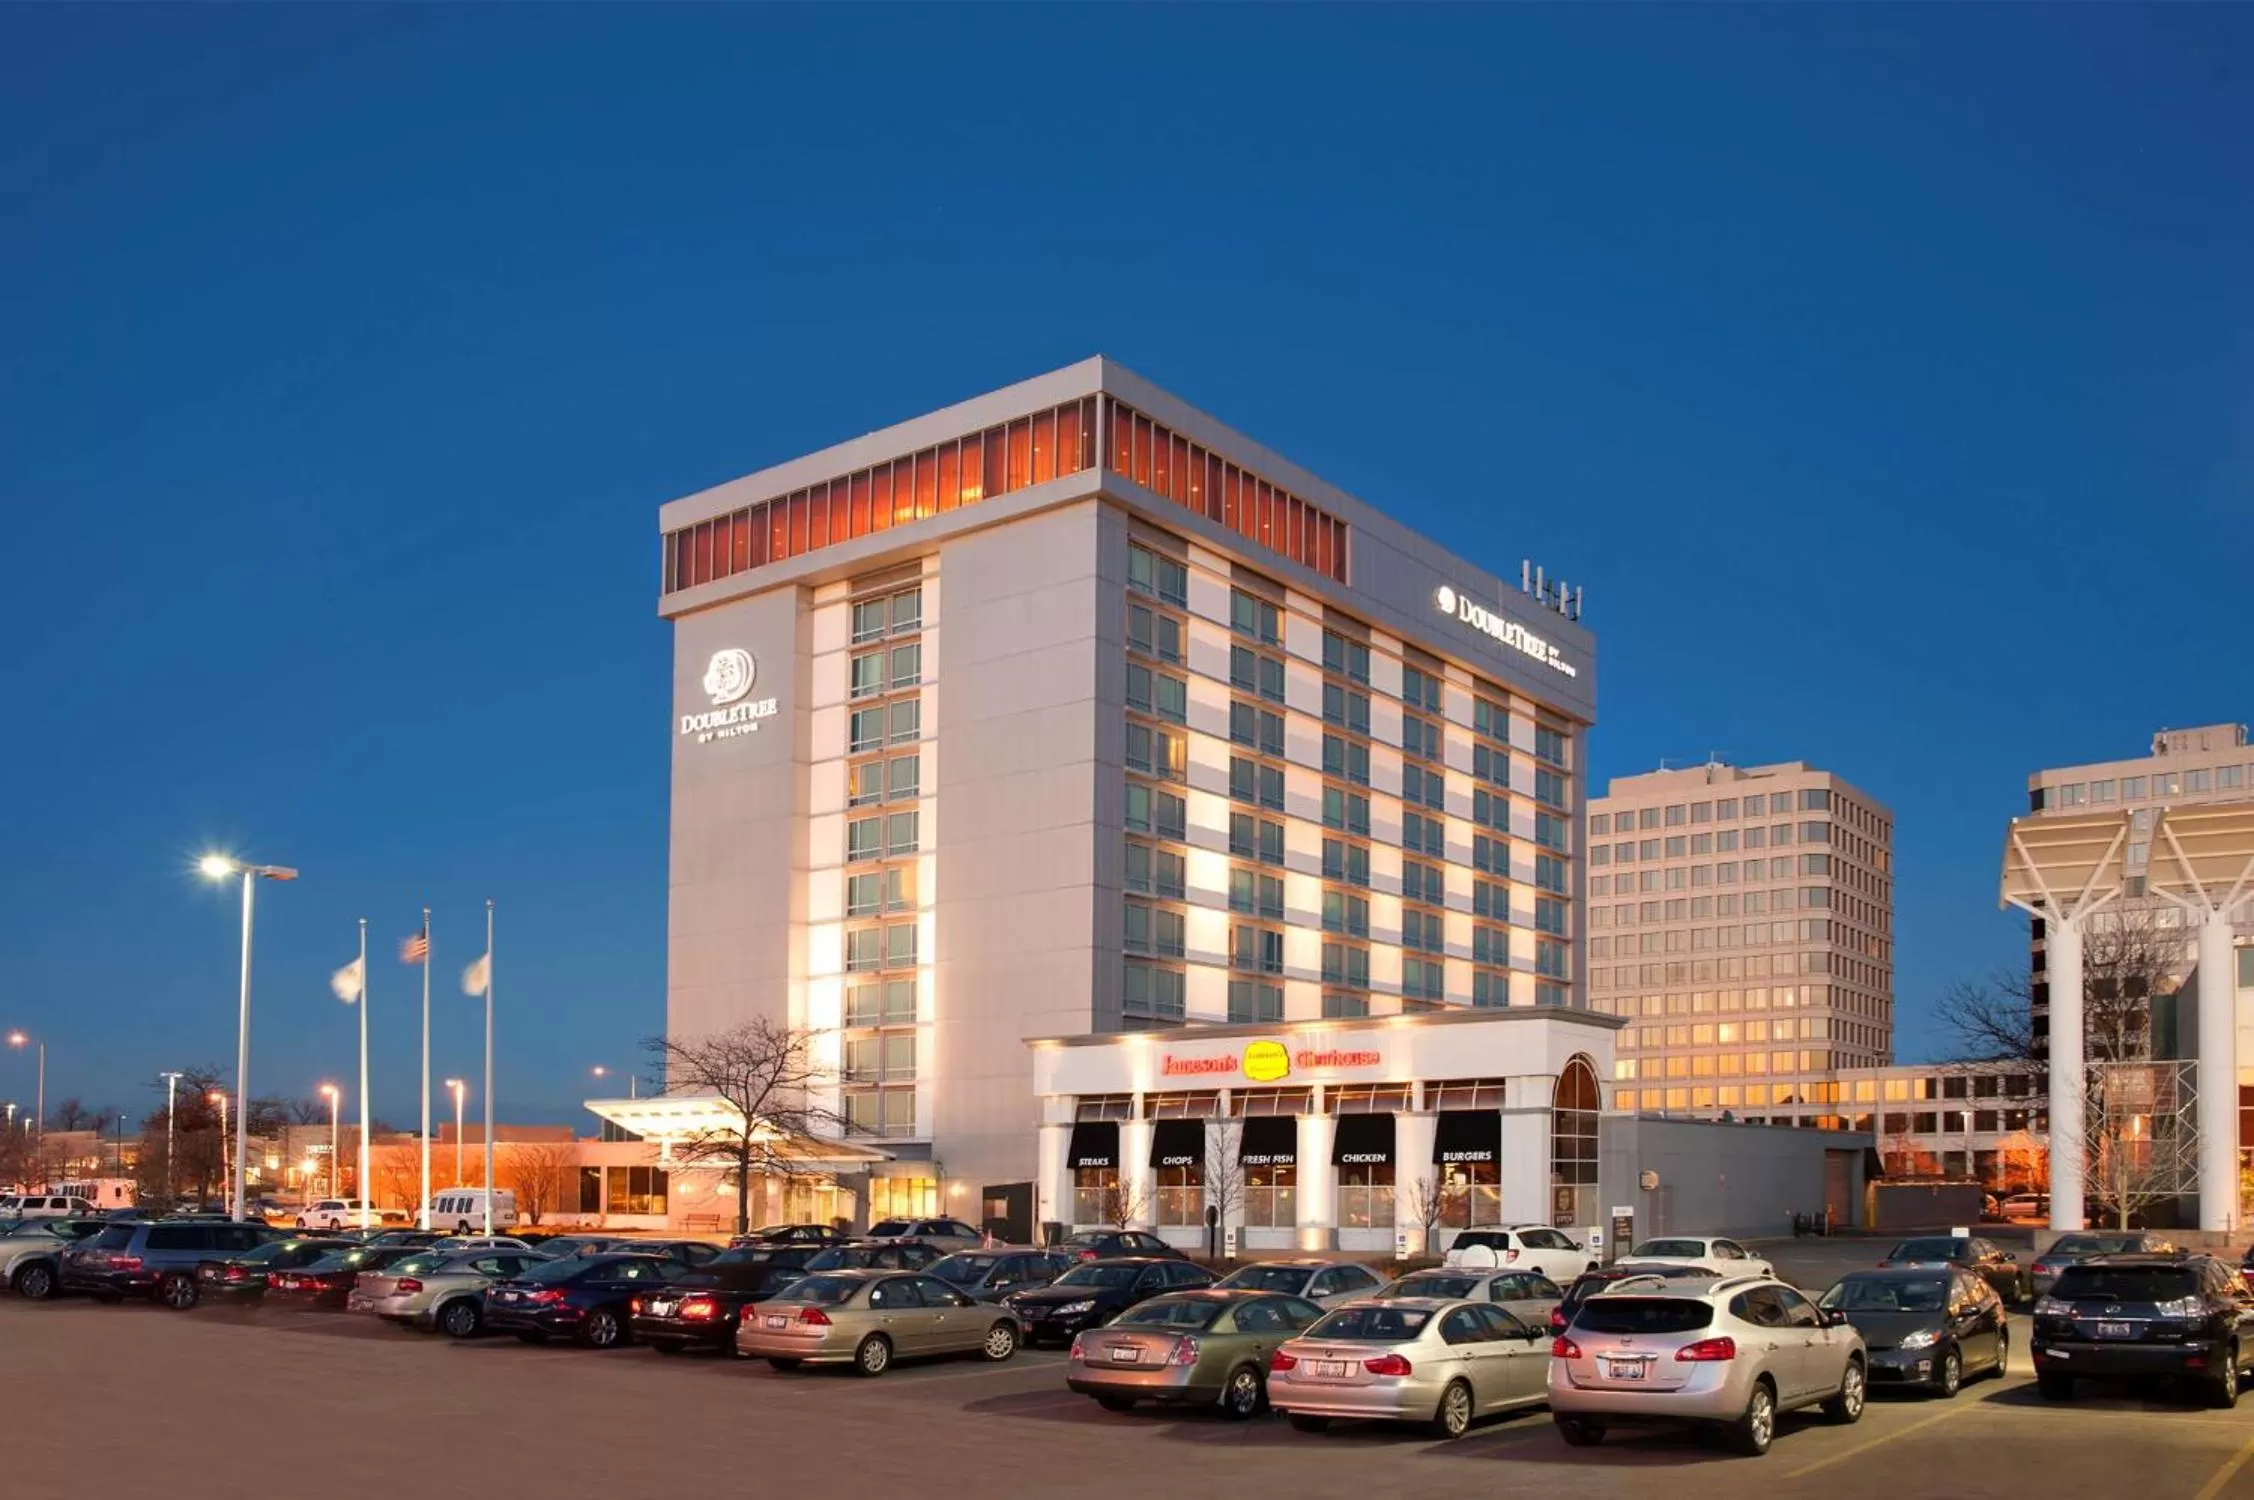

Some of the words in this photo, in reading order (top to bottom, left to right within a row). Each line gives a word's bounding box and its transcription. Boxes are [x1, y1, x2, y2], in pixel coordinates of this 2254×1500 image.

[698, 732, 714, 743] BY
[717, 722, 759, 738] HILTON
[1162, 1156, 1193, 1165] CHOPS
[1242, 1155, 1271, 1164] FRESH
[1272, 1154, 1294, 1164] FISH
[1342, 1153, 1387, 1163] CHICKEN
[1442, 1151, 1492, 1161] BURGERS
[1078, 1157, 1109, 1166] STEAKS
